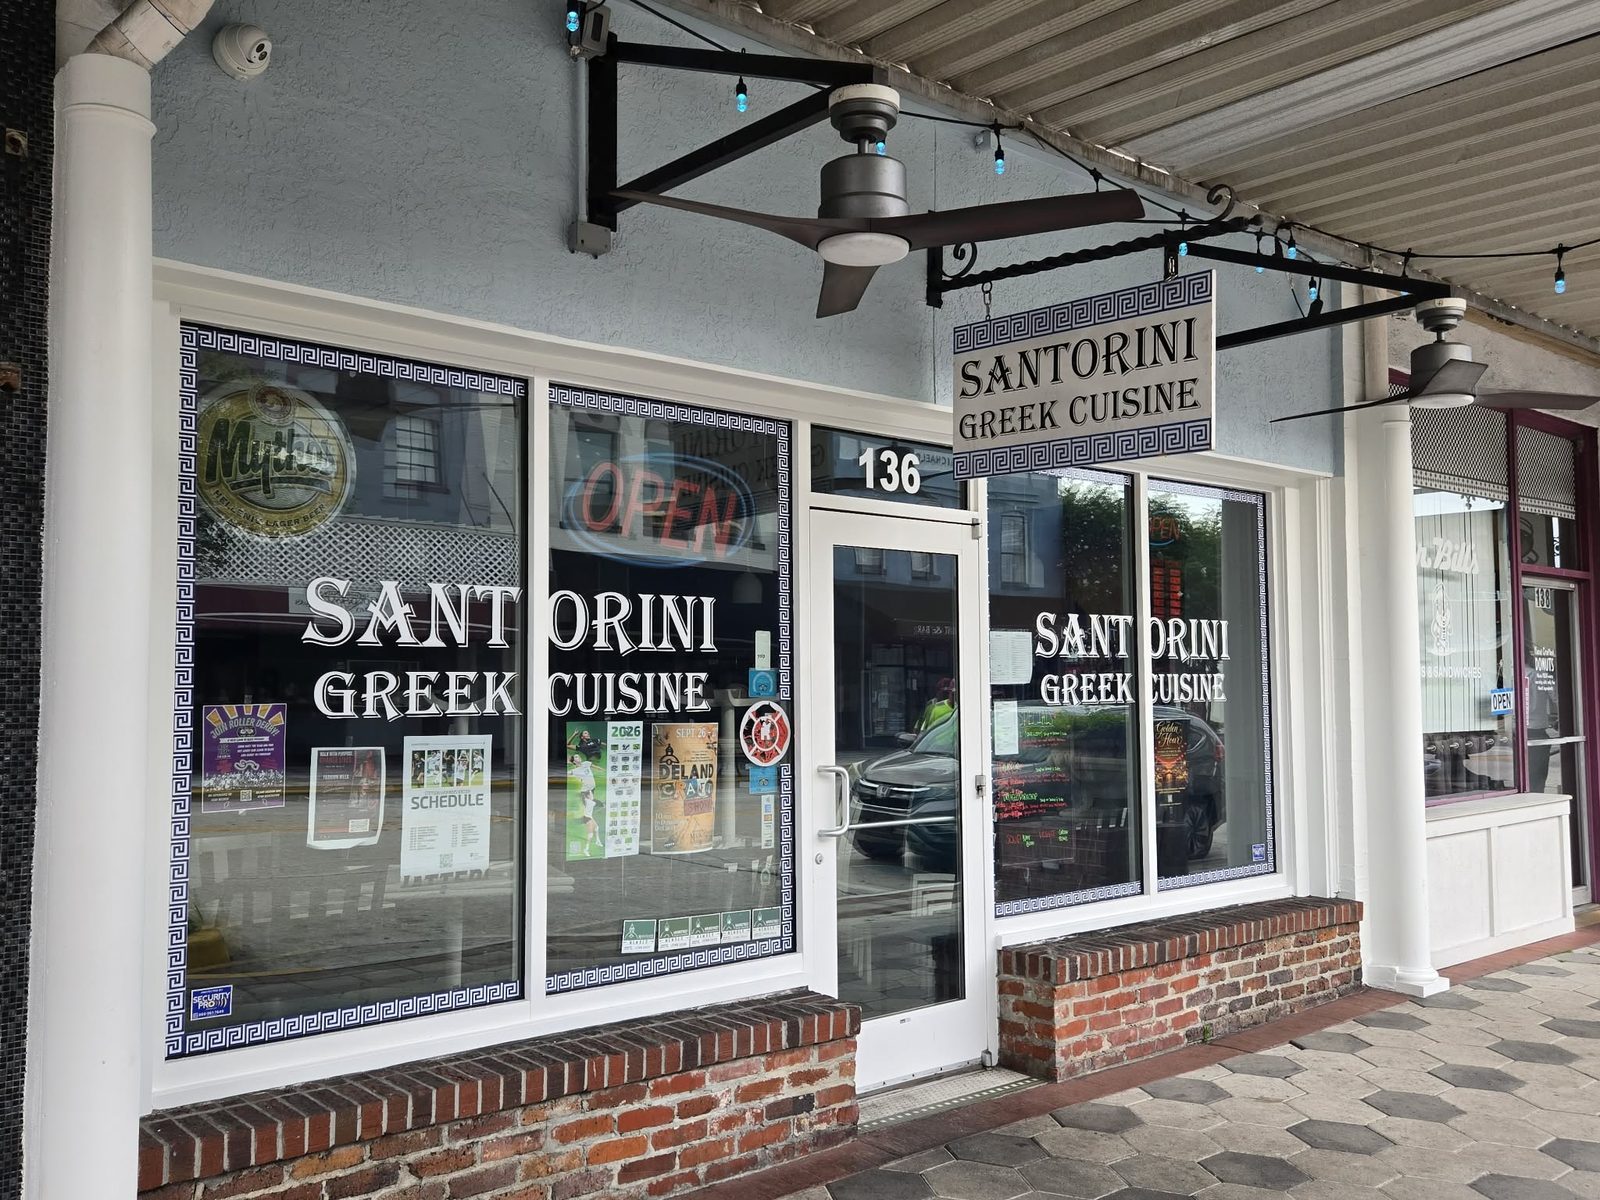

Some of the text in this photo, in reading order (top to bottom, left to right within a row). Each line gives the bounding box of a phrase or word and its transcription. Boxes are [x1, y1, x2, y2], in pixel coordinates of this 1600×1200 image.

[959, 317, 1199, 400] SANTORINI
[959, 377, 1201, 441] GREEK CUISINE
[858, 446, 921, 495] 136
[266, 518, 300, 528] LAGER
[303, 503, 326, 523] BEER
[581, 462, 737, 558] OPEN
[1535, 588, 1550, 608] 138
[1434, 666, 1482, 679] SANDWICHES
[1534, 657, 1554, 672] DONUTS
[313, 670, 712, 723] GREEK CUISINE
[1040, 673, 1227, 706] GREEK CUISINE
[1492, 692, 1512, 711] OPEN
[210, 717, 281, 739] JOIN ROLLER DERBY!
[611, 725, 641, 738] 2026
[659, 763, 714, 780] DELAND
[410, 793, 485, 810] SCHEDULE
[193, 991, 231, 1004] SECURITY
[198, 1000, 216, 1010] PRO
